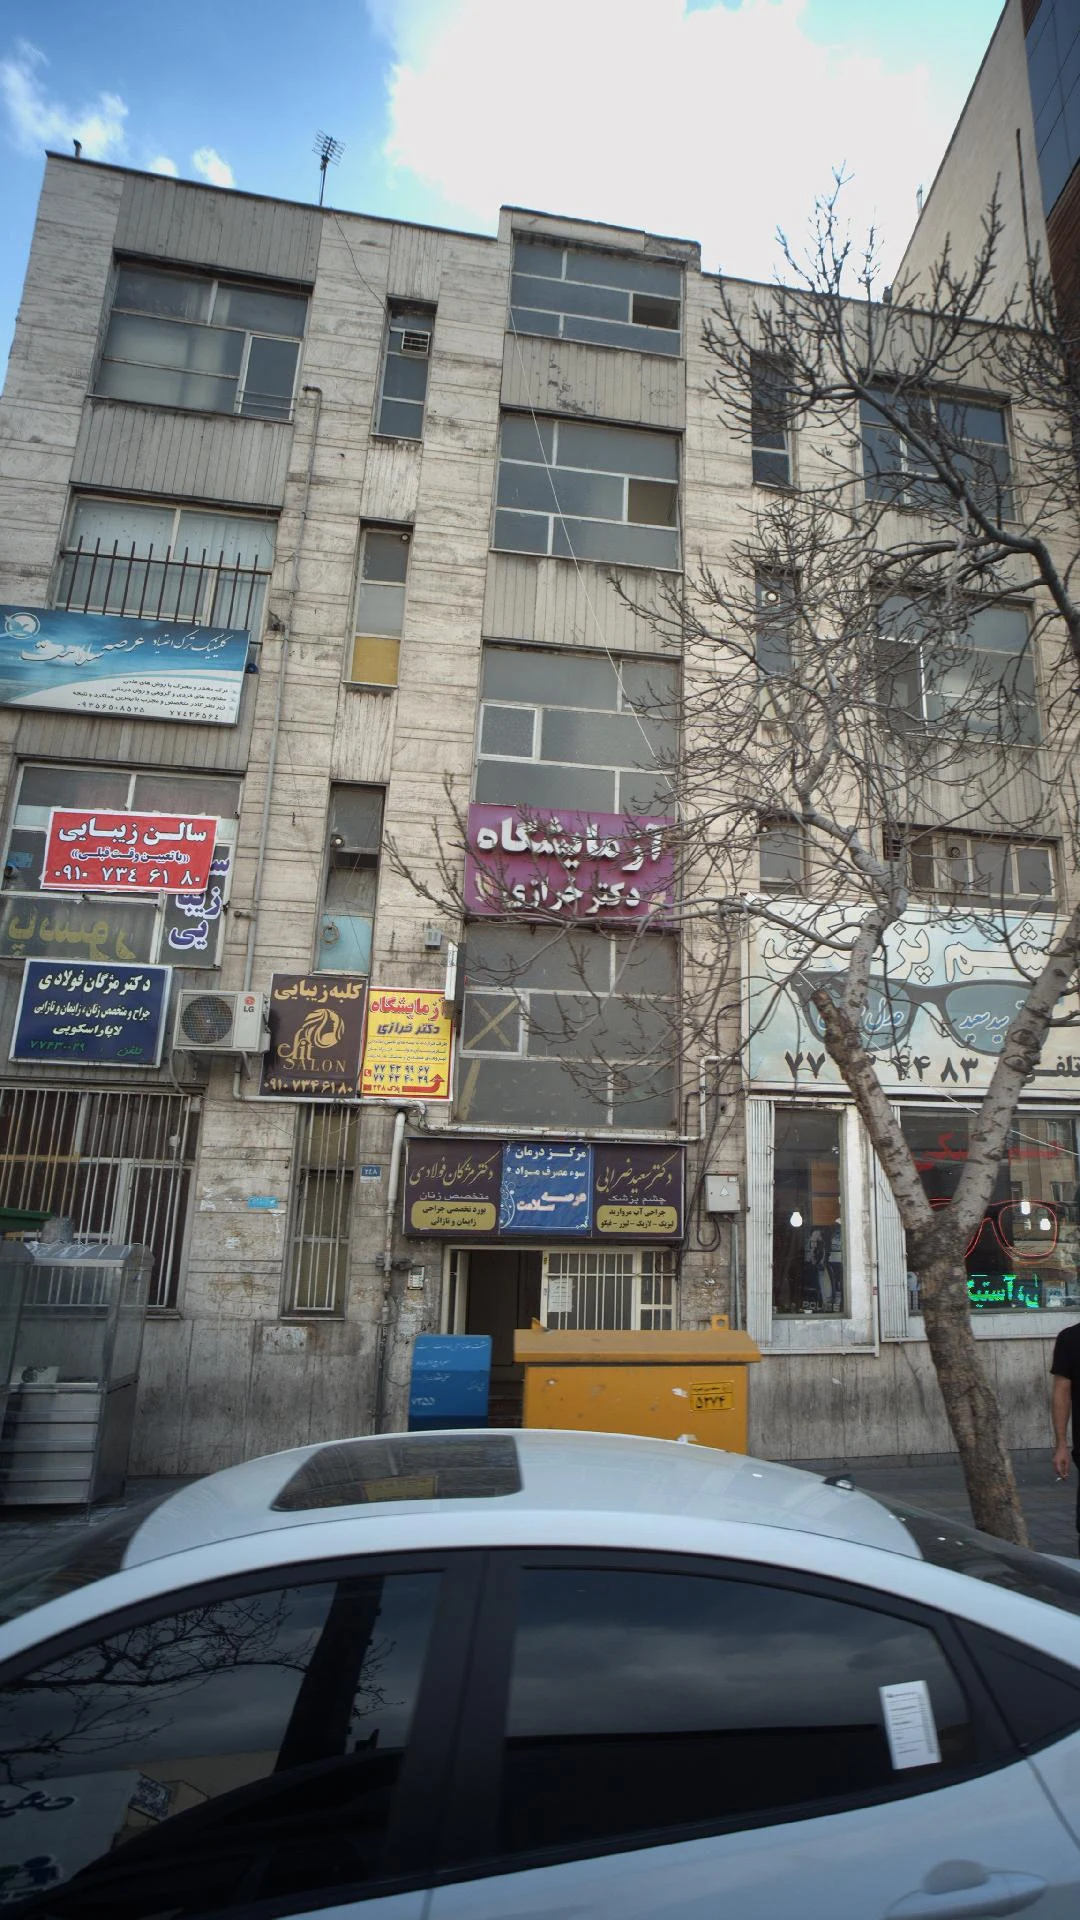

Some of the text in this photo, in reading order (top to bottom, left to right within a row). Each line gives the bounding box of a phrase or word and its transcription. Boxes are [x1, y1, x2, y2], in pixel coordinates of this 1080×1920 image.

[153, 634, 174, 654] اعتیاد
[173, 629, 200, 650] ترک
[191, 632, 234, 660] کلینیک
[58, 817, 207, 845] سالن زیبایی
[477, 816, 662, 871] آزمایشگاه
[111, 848, 141, 863] وقت
[54, 863, 88, 881] ۰۹۱۰
[149, 867, 169, 885] ۶۱
[180, 869, 201, 886] ۸۰
[585, 881, 641, 914] دکتر
[38, 969, 151, 996] دکتر مژگان فولادی
[273, 979, 363, 1004] کلبه زیبایی
[33, 999, 57, 1015] نازایی
[54, 1006, 60, 1015] و
[60, 1001, 83, 1017] زایمان
[100, 1005, 127, 1018] متخصص
[126, 1010, 132, 1020] و
[132, 1006, 151, 1021] جراح
[243, 1005, 255, 1013] LG
[52, 1023, 123, 1039] لاپاراسکوپی
[376, 1021, 441, 1035] دکتر خرازی
[959, 1011, 991, 1043] سعید
[282, 1058, 347, 1073] SALON
[373, 1064, 386, 1073] ۷۷
[515, 1145, 587, 1161] مرکز درمان
[408, 1150, 501, 1186] دکتر مژگان فولادی
[515, 1165, 586, 1180] سوء مصرف مواد
[643, 1150, 680, 1191] دکتر
[627, 1171, 652, 1194] سعید
[419, 1191, 489, 1201] متخصص زنان
[422, 1204, 446, 1214] جراحی
[516, 1198, 556, 1212] سلامت
[633, 1207, 644, 1216] آب
[644, 1208, 667, 1217] جراحی
